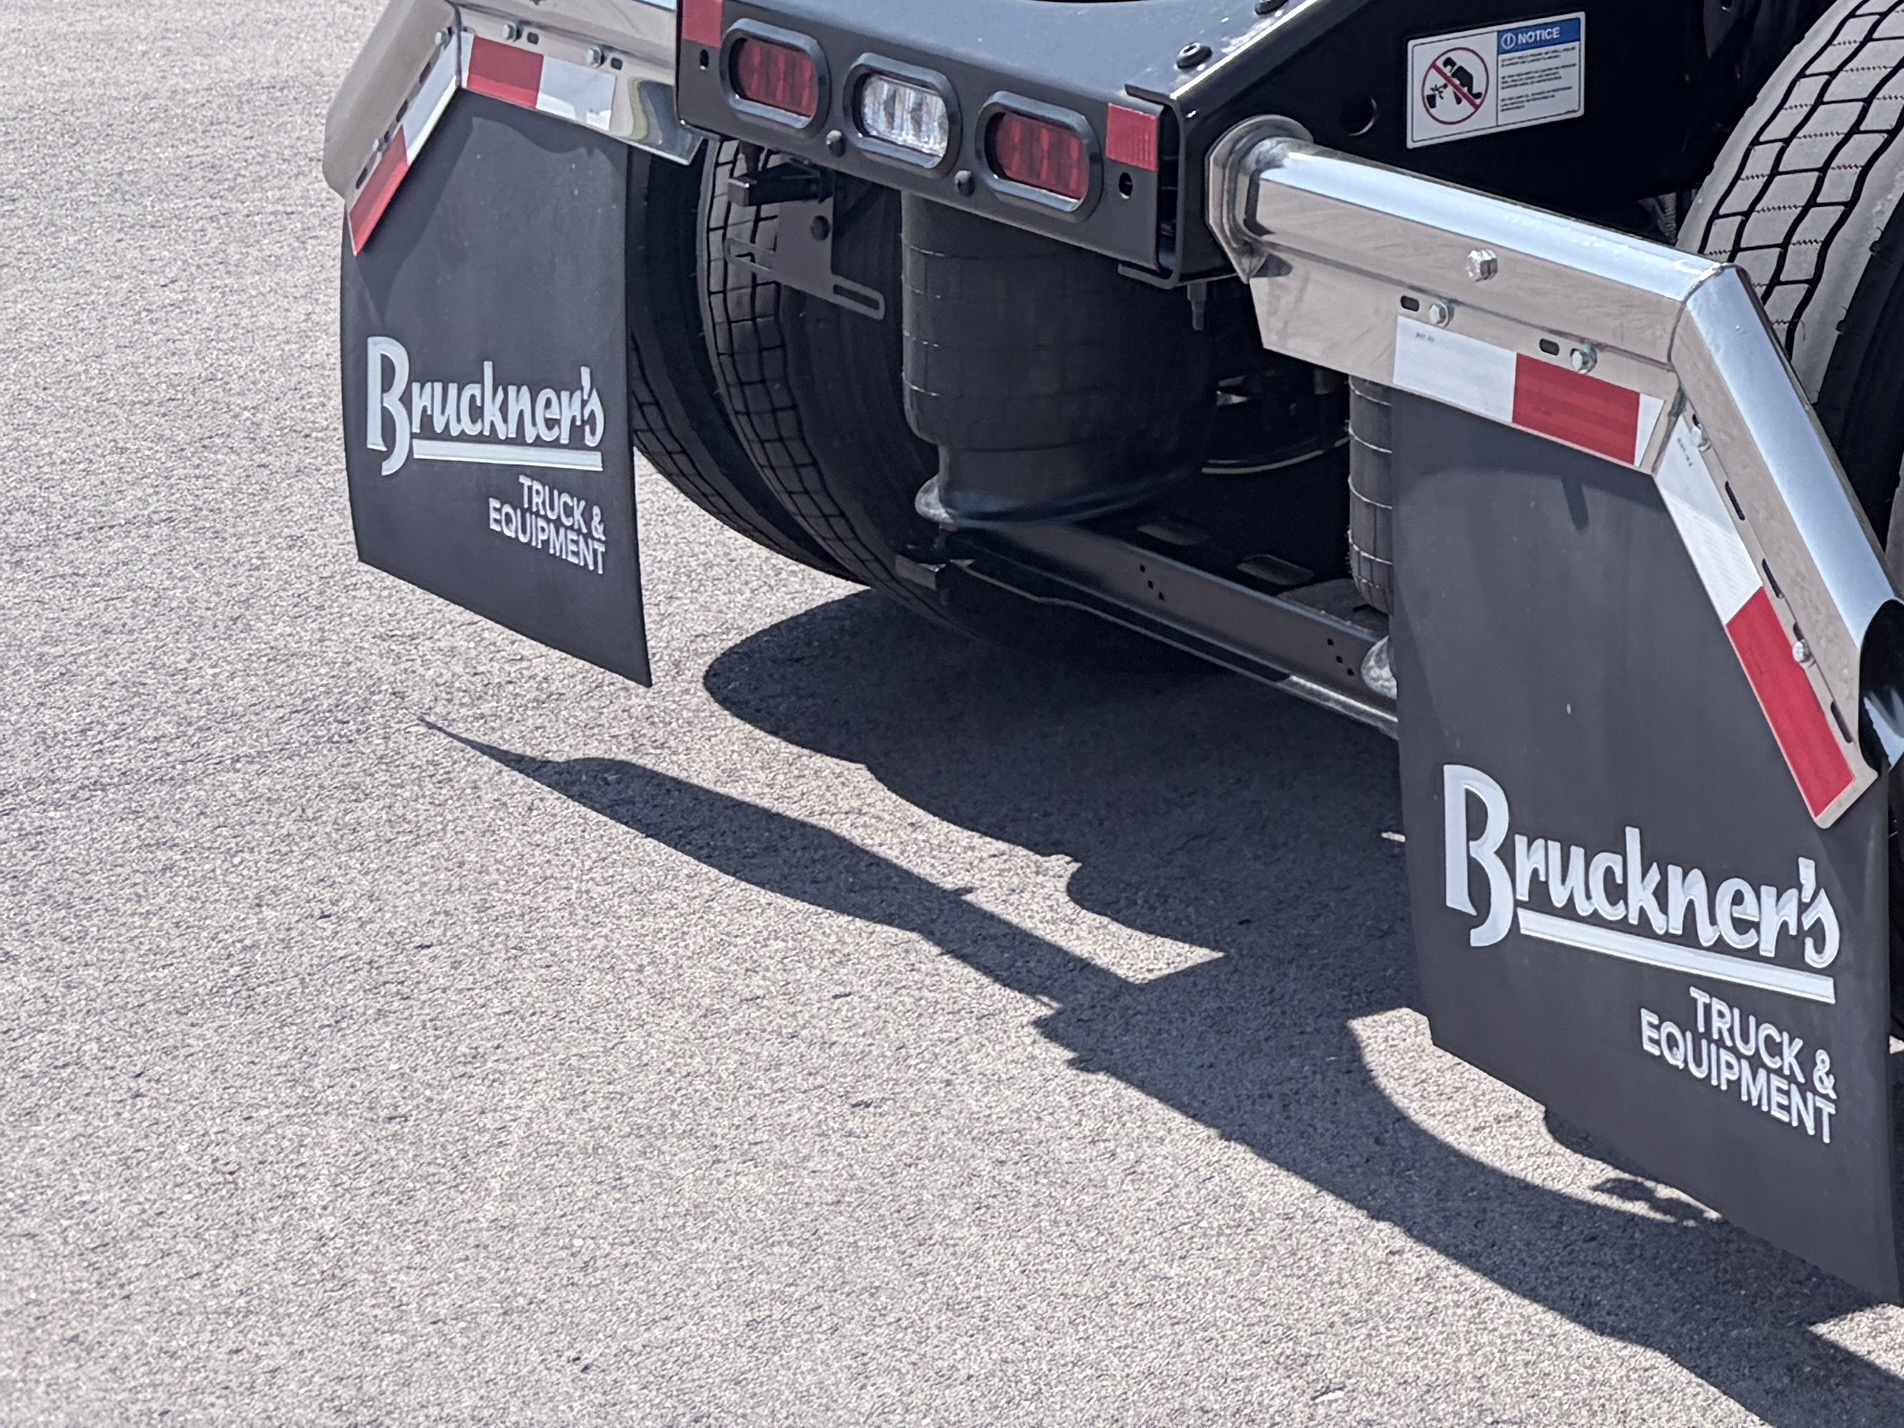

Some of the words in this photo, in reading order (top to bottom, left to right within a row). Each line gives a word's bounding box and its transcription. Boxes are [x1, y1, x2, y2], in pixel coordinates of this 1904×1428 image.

[1517, 27, 1560, 45] NOTICE
[367, 335, 605, 476] Bruckner's
[488, 497, 606, 575] EQUIPMENT
[519, 474, 587, 534] TRUCK
[591, 505, 606, 541] &
[1443, 764, 1841, 969] Bruckner's
[1640, 1007, 1837, 1145] EQUIPMENT
[1689, 986, 1805, 1084] TRUCK
[1812, 1048, 1838, 1100] &
